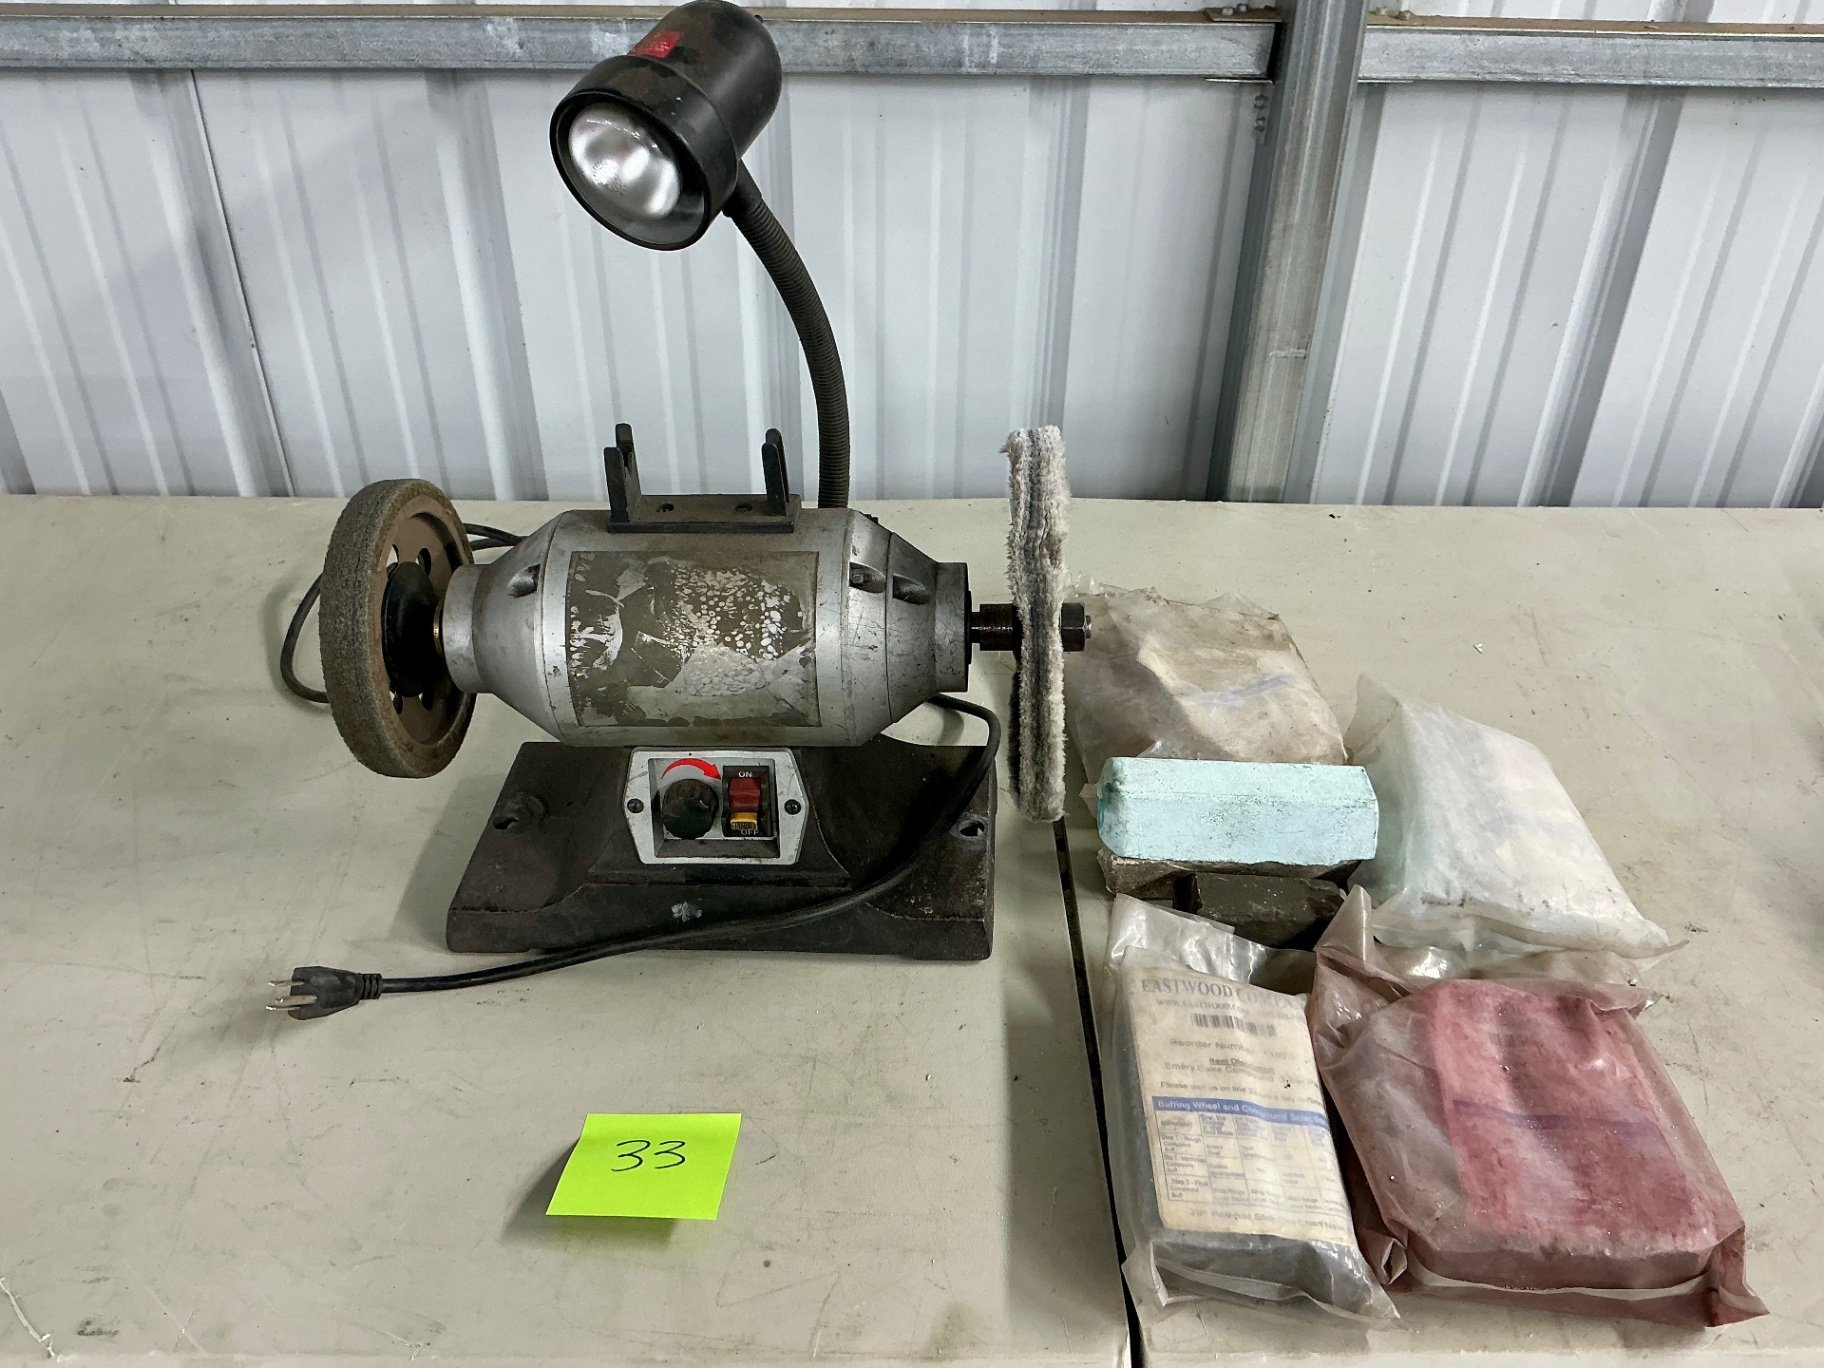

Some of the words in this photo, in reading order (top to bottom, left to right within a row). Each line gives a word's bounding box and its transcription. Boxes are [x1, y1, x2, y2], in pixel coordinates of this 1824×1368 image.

[738, 770, 753, 778] ON
[1141, 978, 1233, 998] EASTWOOD
[1157, 1101, 1191, 1111] Buffing
[1192, 1102, 1221, 1110] Wheel
[1223, 1103, 1240, 1111] and
[611, 1139, 686, 1172] 33
